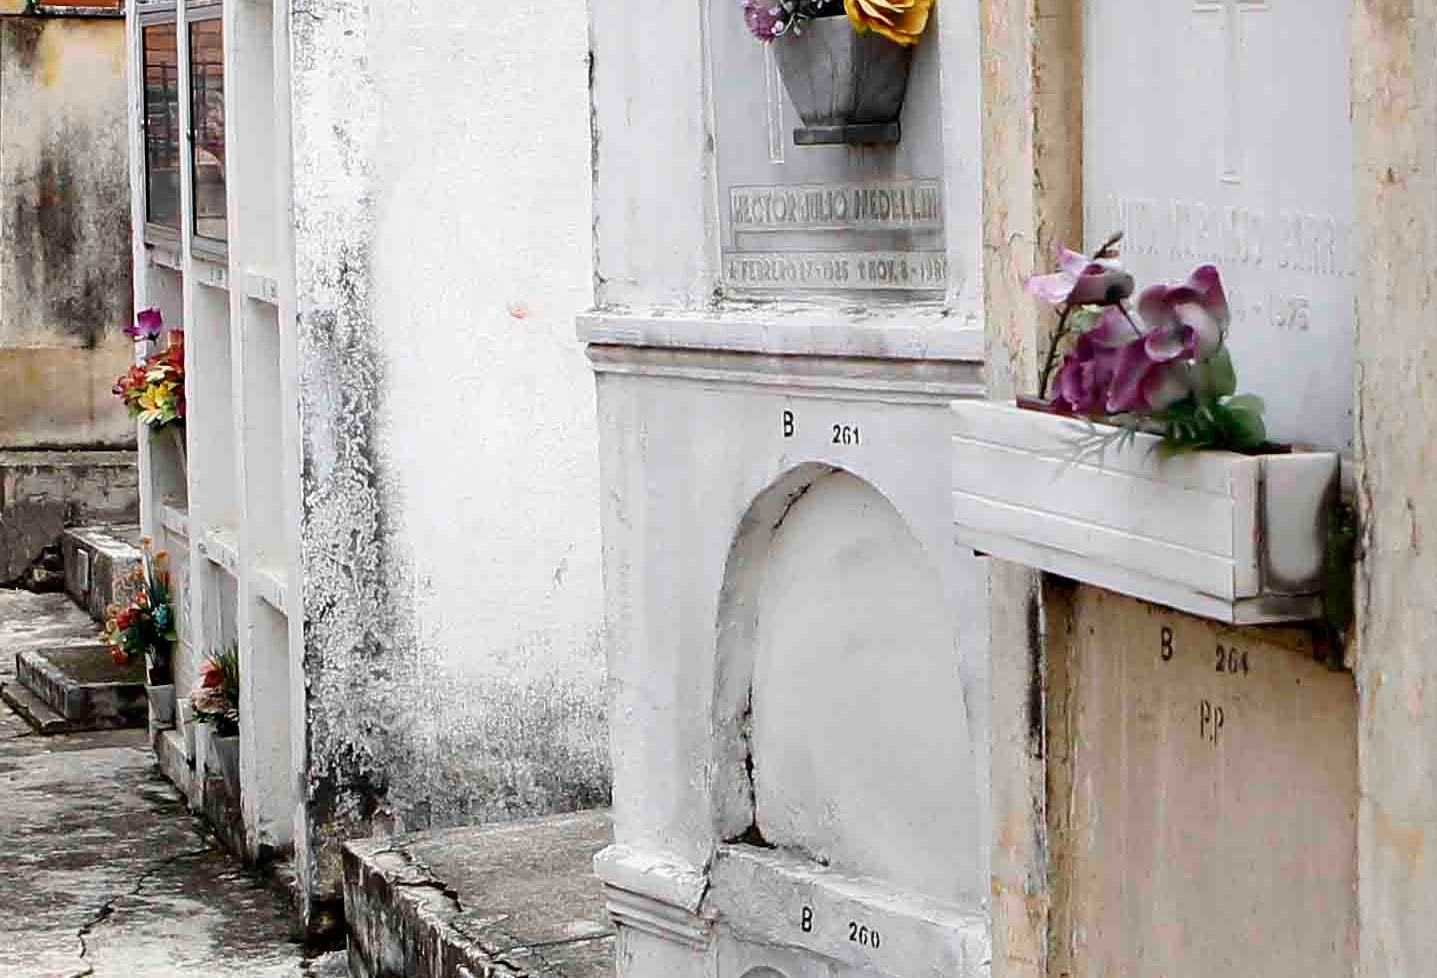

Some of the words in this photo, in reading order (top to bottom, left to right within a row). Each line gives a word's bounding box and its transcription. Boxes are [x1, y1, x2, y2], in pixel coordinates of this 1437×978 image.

[734, 190, 799, 224] HECTOR
[783, 409, 794, 438] B
[832, 424, 860, 446] 261
[1160, 626, 1173, 662] B
[801, 906, 812, 933] B
[848, 921, 880, 950] 260
